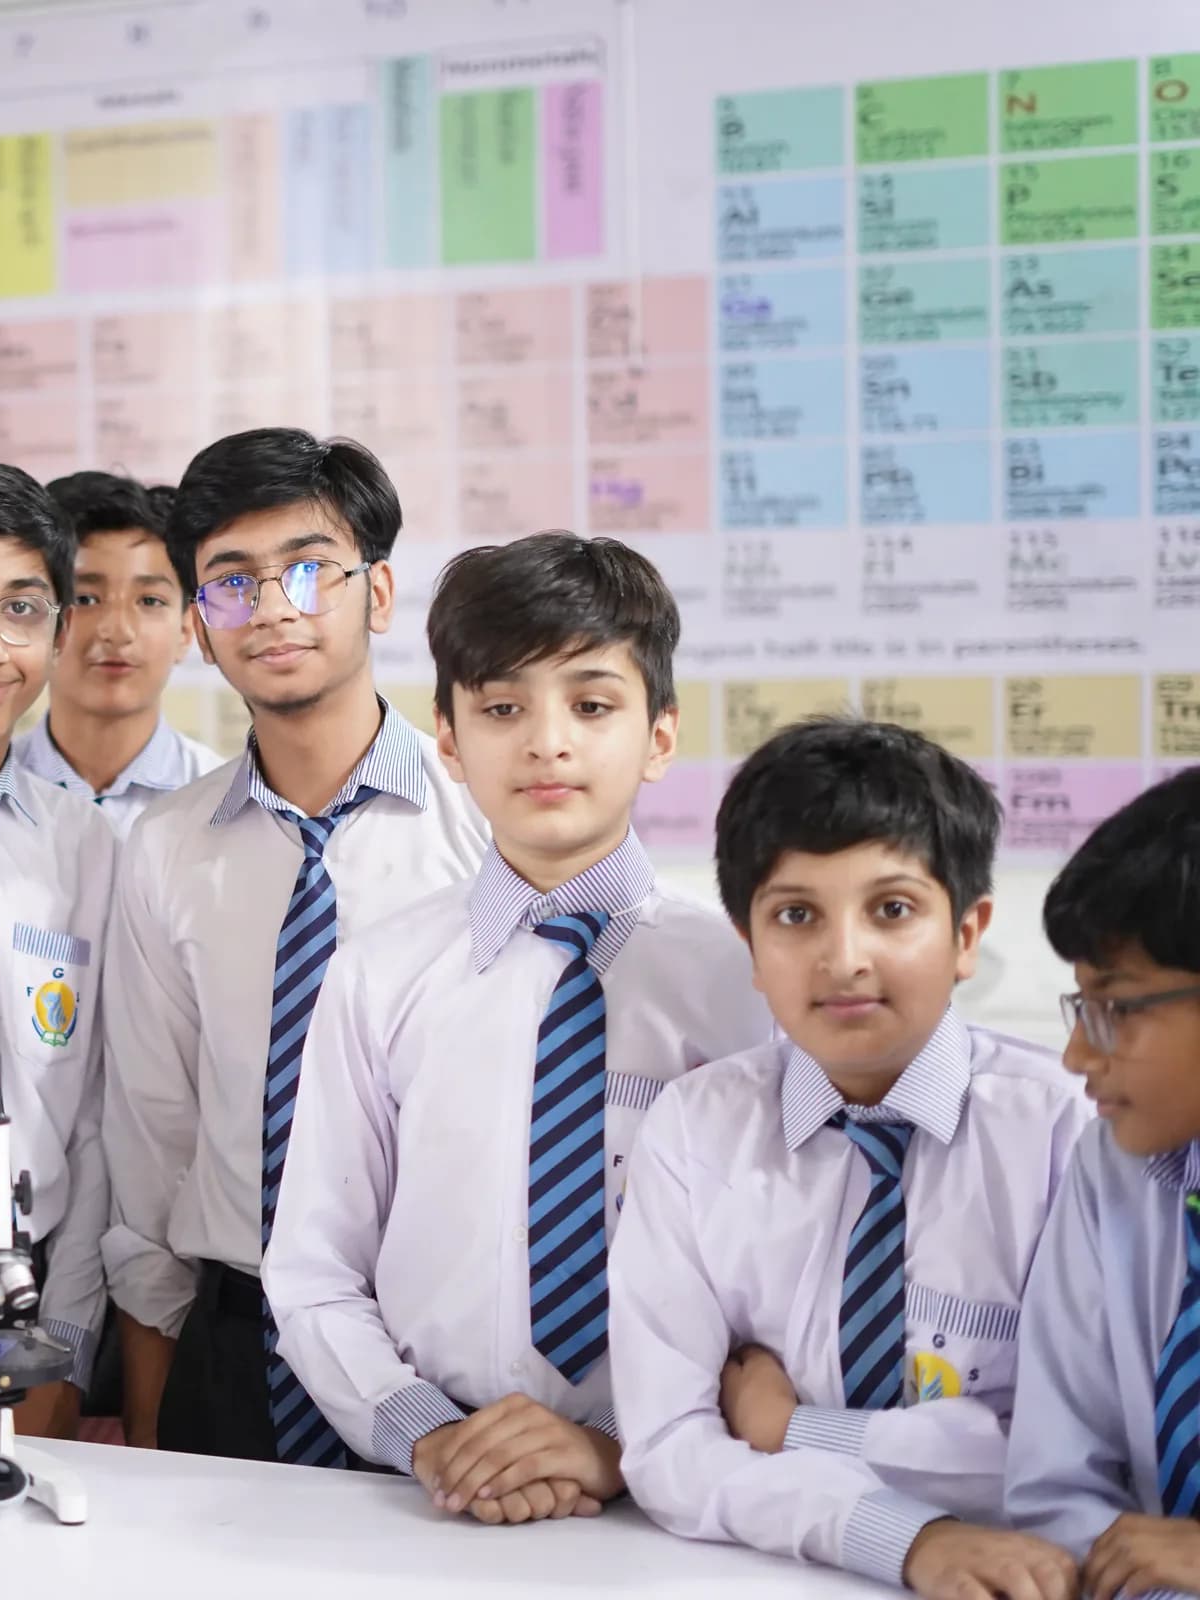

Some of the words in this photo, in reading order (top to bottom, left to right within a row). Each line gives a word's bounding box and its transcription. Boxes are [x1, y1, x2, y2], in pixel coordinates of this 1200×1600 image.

[1155, 79, 1189, 104] O
[1006, 92, 1037, 117] N
[1007, 183, 1032, 207] P
[1157, 173, 1179, 197] S
[1004, 278, 1054, 298] As
[1010, 369, 1058, 393] Sb
[1161, 361, 1199, 383] Te
[26, 987, 34, 997] F
[53, 967, 65, 979] G
[613, 1154, 624, 1168] F
[932, 1333, 946, 1349] G
[968, 1368, 980, 1381] S
